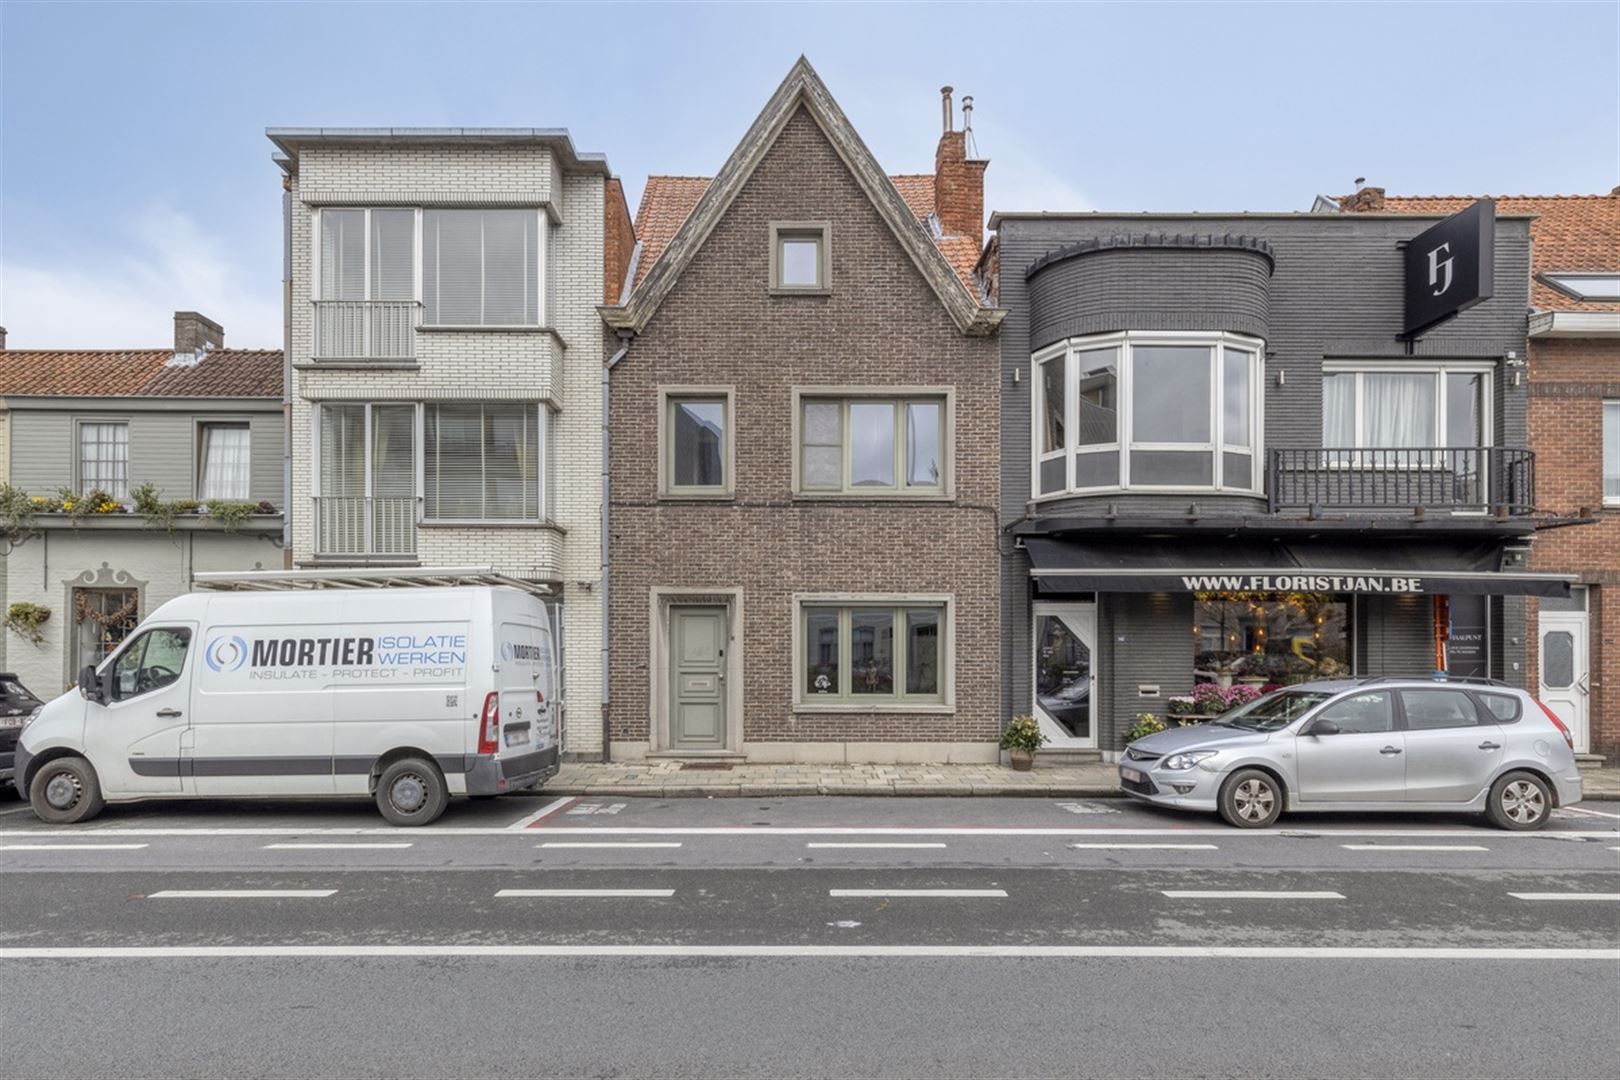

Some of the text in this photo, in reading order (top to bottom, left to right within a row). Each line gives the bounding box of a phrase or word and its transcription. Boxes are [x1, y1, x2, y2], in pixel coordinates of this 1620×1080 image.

[1182, 576, 1424, 592] WWW.FLORISTJAN.BE
[377, 635, 466, 650] ISOLATIE
[251, 637, 375, 667] MORTIER
[378, 651, 466, 665] WERKEN
[249, 669, 318, 680] INSULATE
[331, 668, 399, 679] PROTECT
[412, 667, 464, 678] PROFIT
